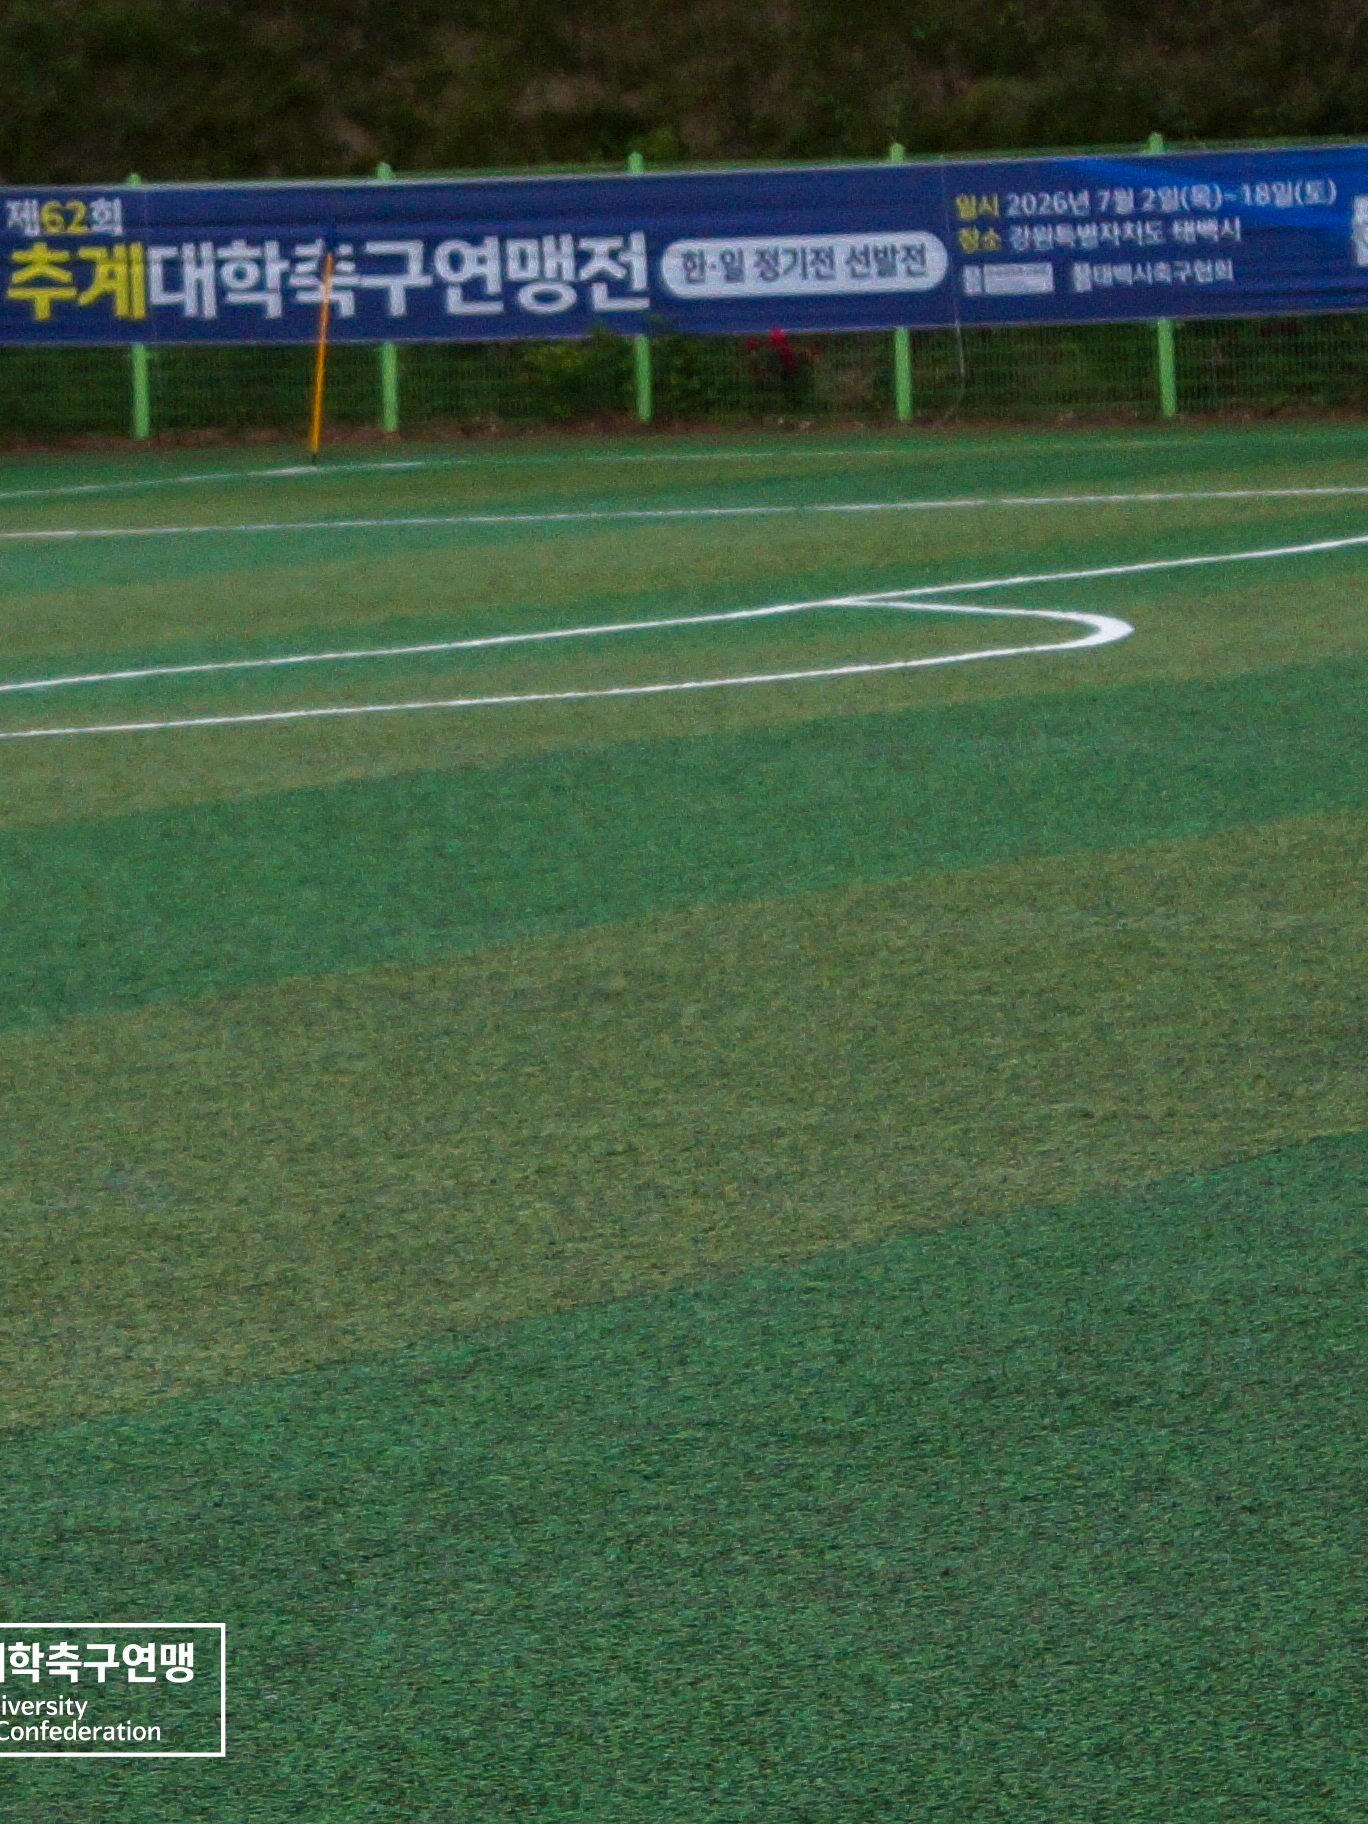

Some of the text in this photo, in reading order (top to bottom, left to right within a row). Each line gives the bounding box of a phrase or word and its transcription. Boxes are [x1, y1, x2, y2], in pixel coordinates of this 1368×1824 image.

[6, 198, 123, 237] 제62회
[1006, 188, 1091, 217] 2026년
[1095, 186, 1135, 215] 7월
[1172, 215, 1243, 245] 태백시
[6, 231, 651, 320] 추계대학축구연맹전
[753, 244, 837, 282] 정기전
[844, 241, 928, 279] 선발전
